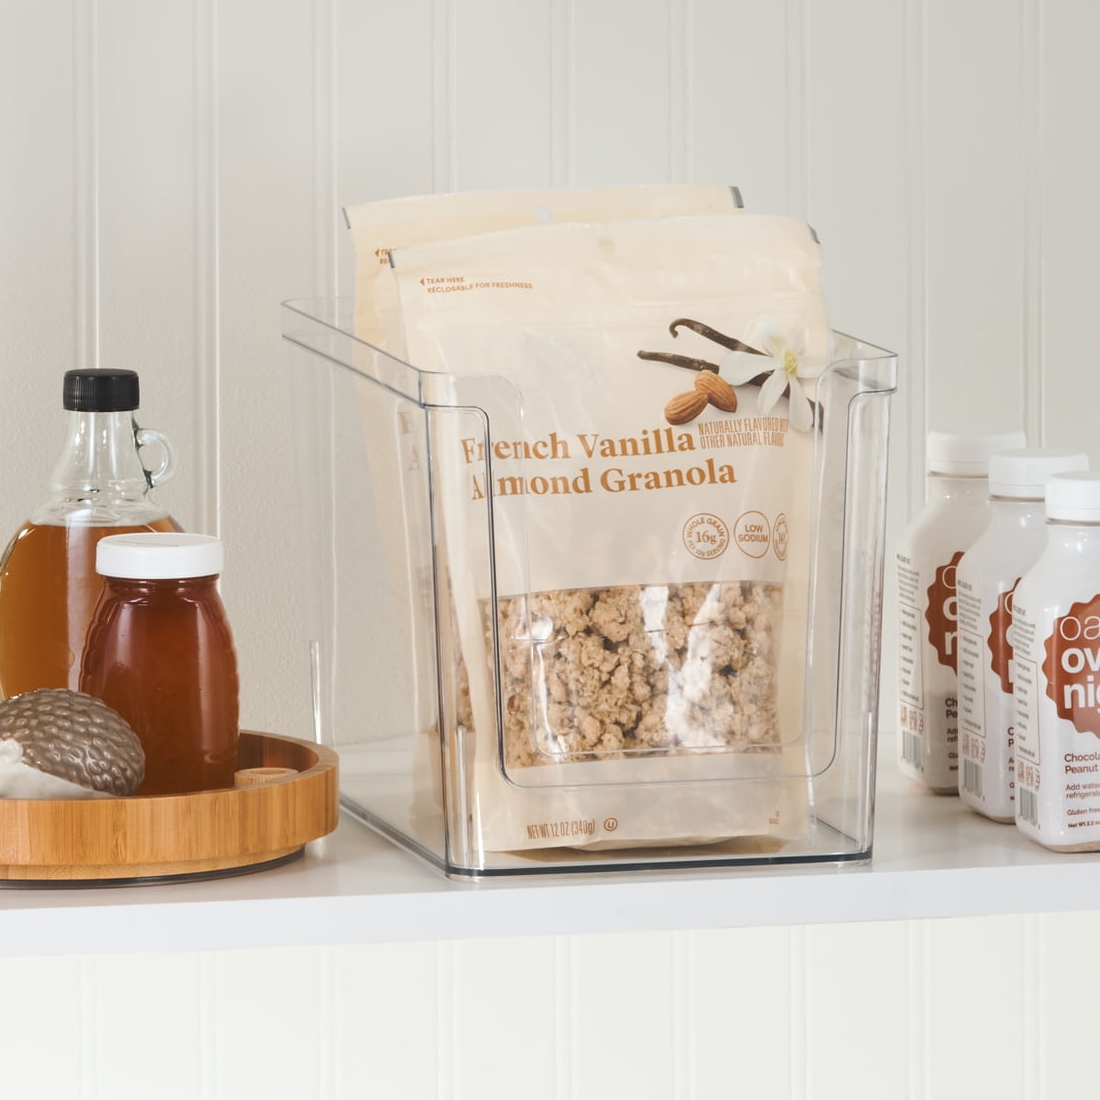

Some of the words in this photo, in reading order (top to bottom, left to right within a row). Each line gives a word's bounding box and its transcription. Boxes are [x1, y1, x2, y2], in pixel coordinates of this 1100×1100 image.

[426, 277, 445, 285] TEAR
[427, 284, 474, 293] RECLOSABLE
[491, 281, 533, 290] FRESHNESS
[698, 418, 742, 436] NATURALLY
[744, 417, 778, 432] FLAVORED
[460, 432, 572, 465] French
[576, 426, 697, 459] Vanilla
[700, 434, 725, 450] OTHER
[727, 432, 762, 448] NATURAL
[470, 467, 593, 501] Amond
[600, 458, 738, 493] Granola
[686, 517, 704, 538] WHOLE
[707, 517, 725, 537] GRAIN
[744, 524, 763, 533] LOW
[695, 530, 717, 544] 16g
[738, 534, 769, 543] SODIUM
[1065, 764, 1099, 774] Peanut
[1065, 783, 1080, 791] Add
[526, 824, 539, 840] NET
[539, 823, 550, 839] WT
[550, 822, 559, 837] 12
[560, 821, 570, 837] OZ
[571, 819, 596, 836] (340g)
